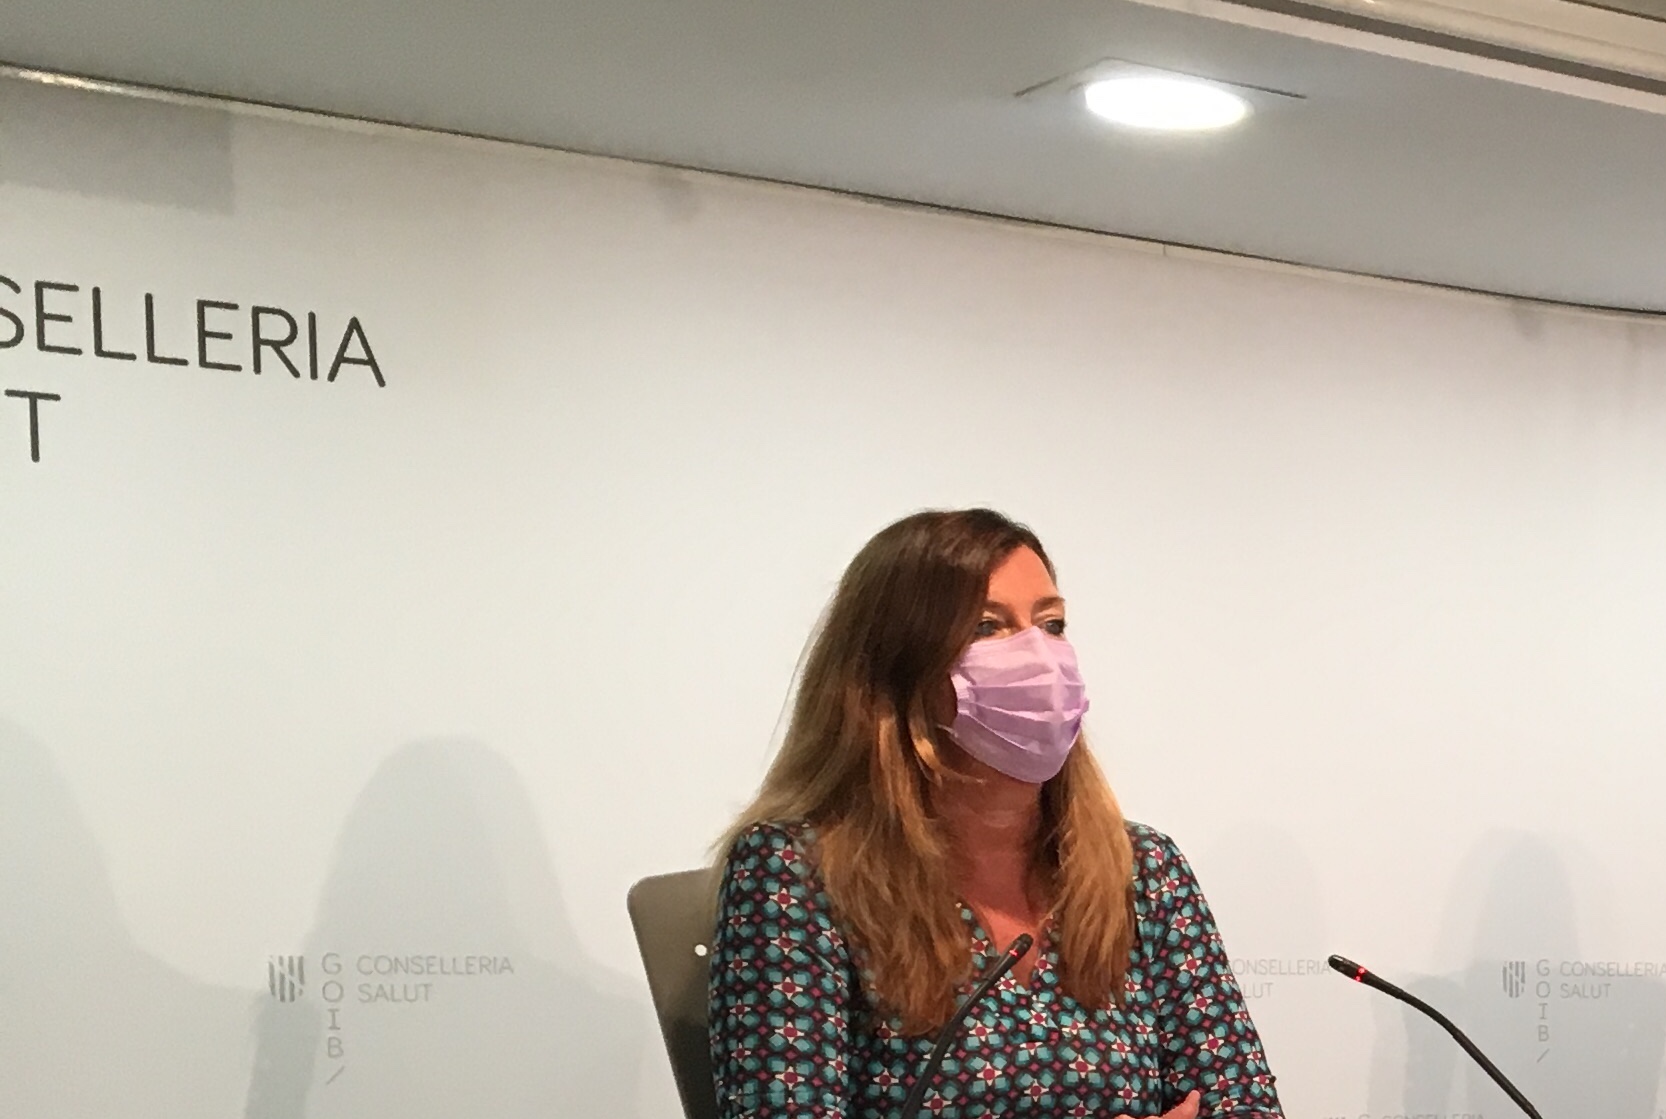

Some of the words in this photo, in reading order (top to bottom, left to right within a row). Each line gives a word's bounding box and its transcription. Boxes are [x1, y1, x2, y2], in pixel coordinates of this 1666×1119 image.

[356, 955, 515, 977] CONSELLERIA
[1226, 957, 1332, 977] ONSELLERIA
[357, 982, 433, 1003] SALUT
[1559, 982, 1612, 1000] SALUT
